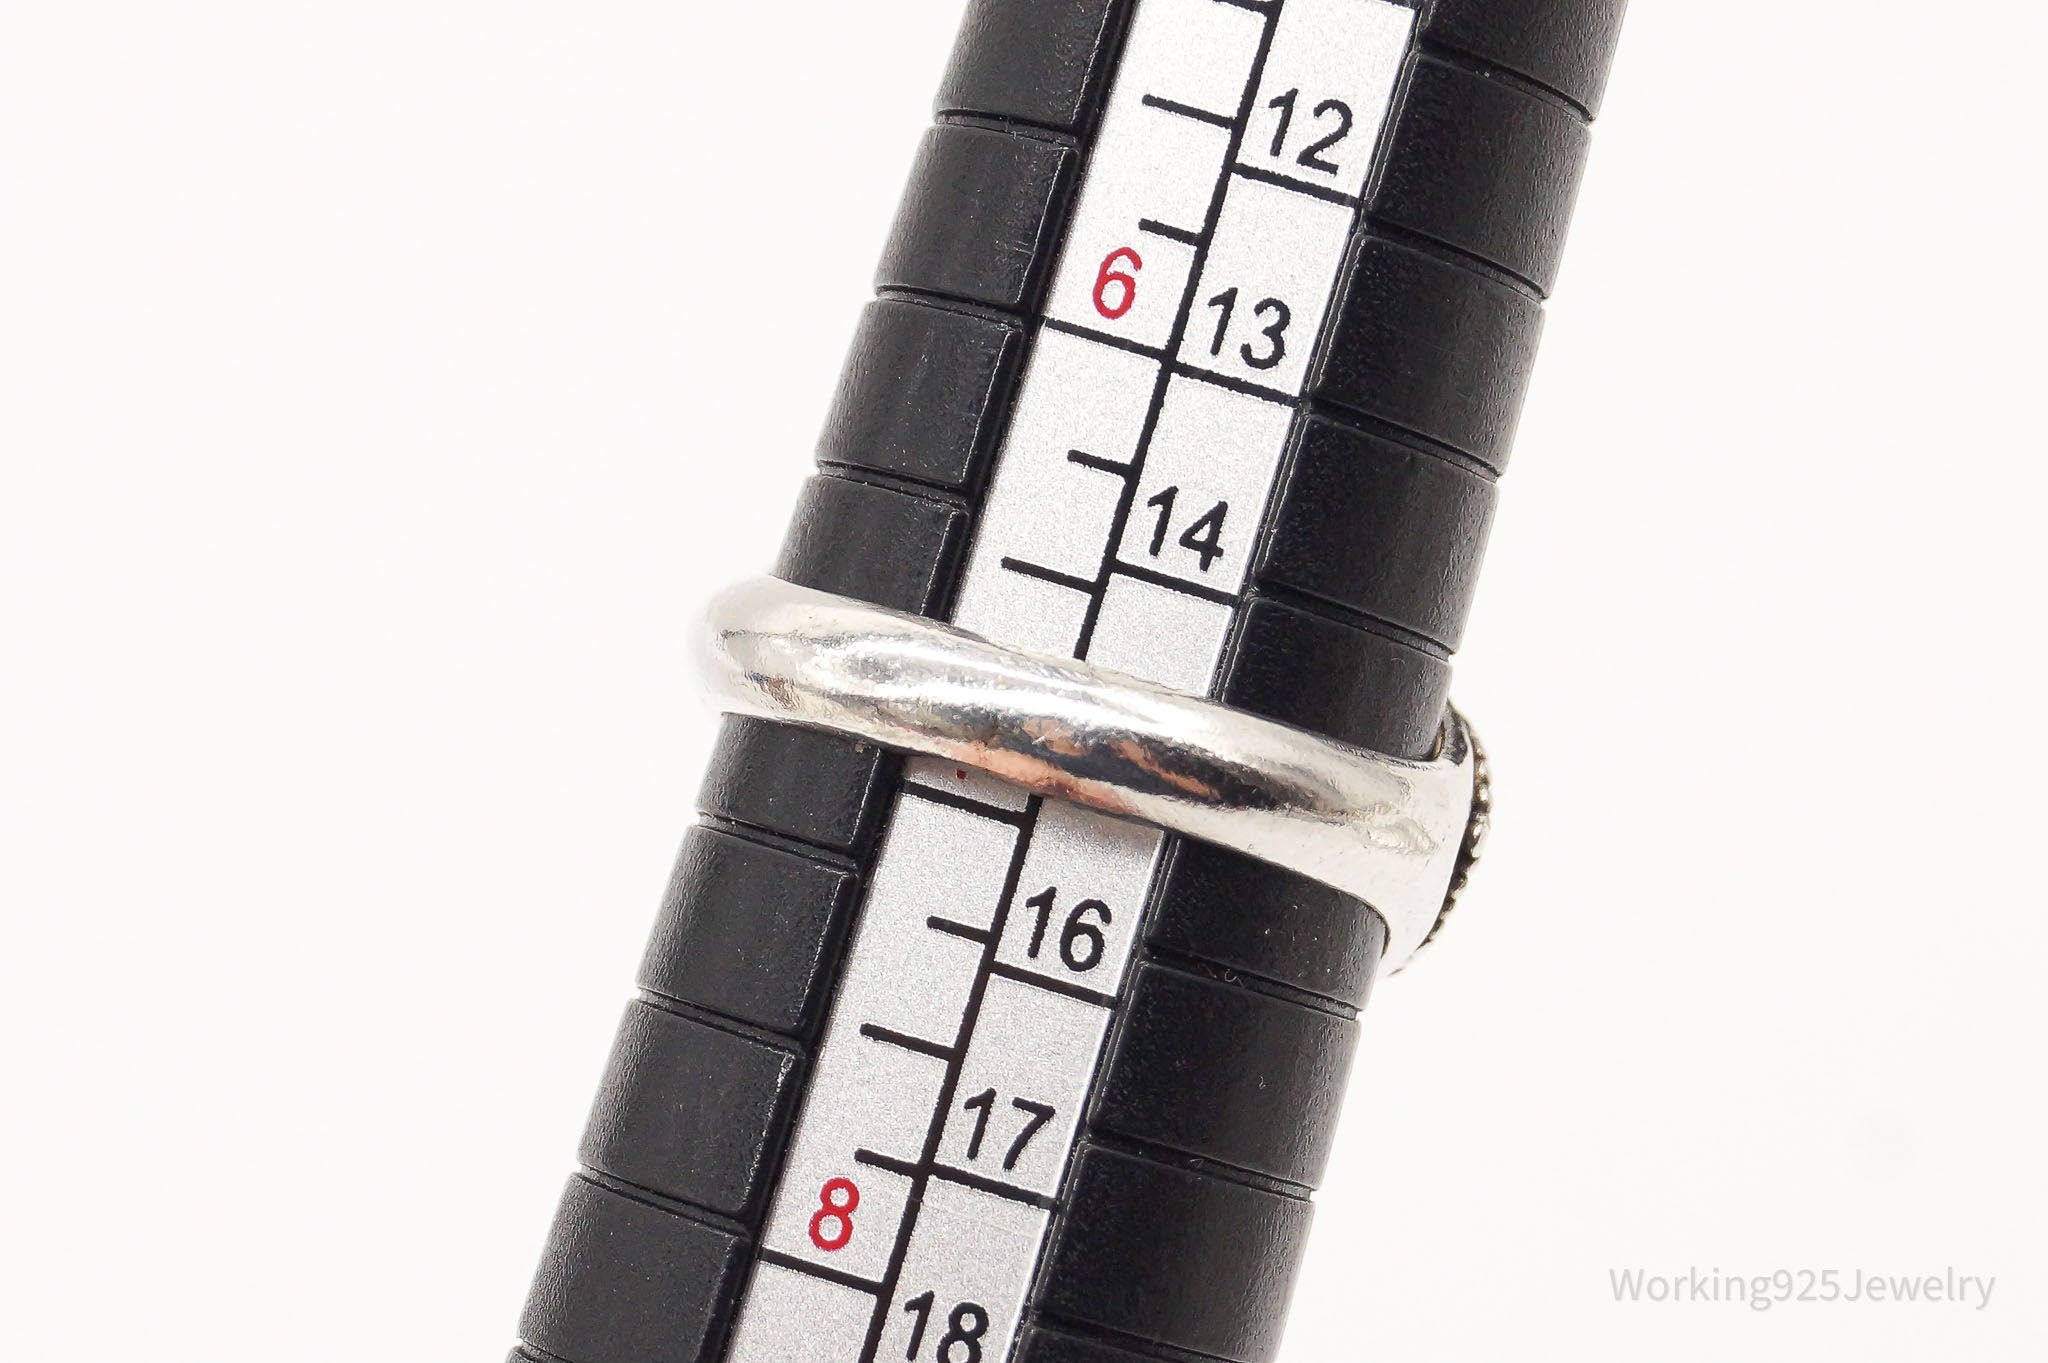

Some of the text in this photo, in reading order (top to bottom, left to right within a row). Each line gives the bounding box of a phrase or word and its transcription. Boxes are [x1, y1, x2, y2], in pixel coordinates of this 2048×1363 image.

[1268, 88, 1353, 176] 12
[1092, 247, 1143, 320] 6
[1207, 287, 1291, 371] 13
[1147, 485, 1228, 573] 14
[1025, 886, 1112, 973] 16
[963, 1087, 1056, 1172] 17
[808, 1177, 860, 1252] 8
[903, 1290, 990, 1363] 18
